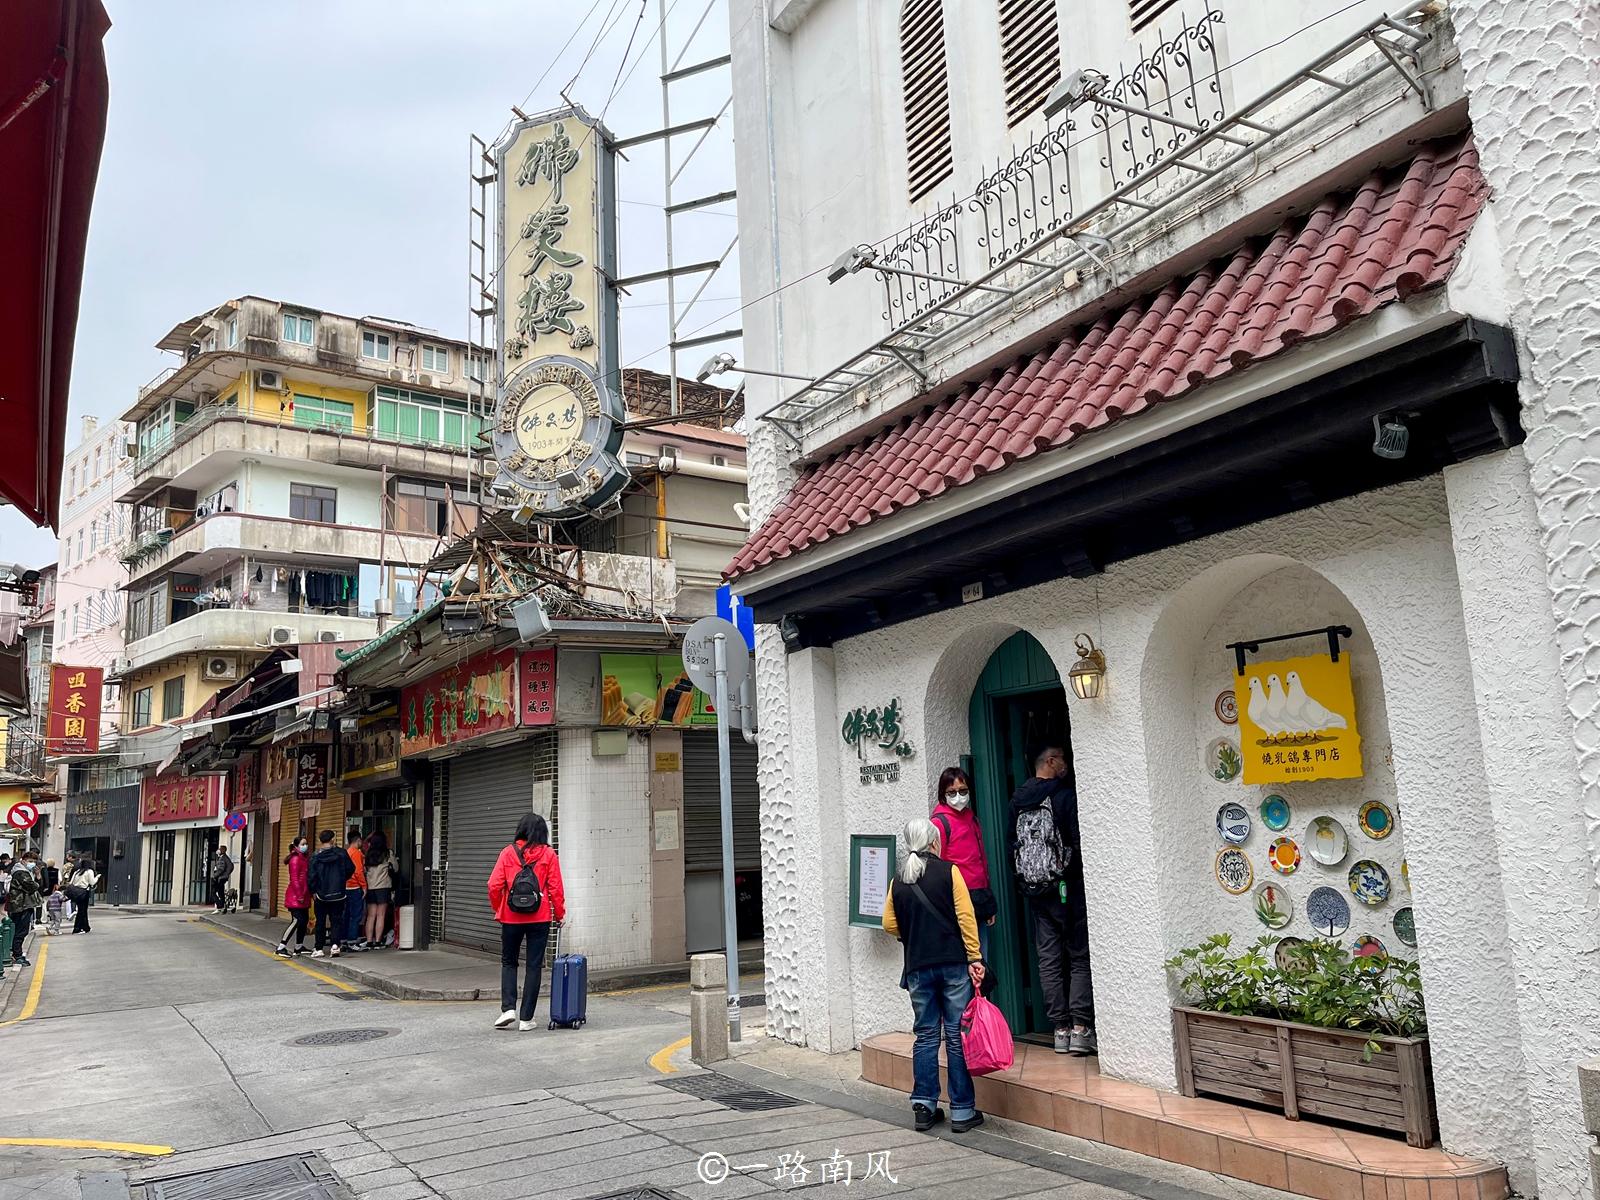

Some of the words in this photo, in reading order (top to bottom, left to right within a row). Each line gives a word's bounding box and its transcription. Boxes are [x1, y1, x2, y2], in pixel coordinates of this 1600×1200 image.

[65, 671, 87, 738] 咀香園
[1262, 748, 1340, 765] 燒乳鴿專門店
[300, 753, 318, 789] 鉅記
[860, 763, 900, 774] RESTAURANTE
[873, 773, 884, 781] SIU
[886, 771, 898, 780] LAU
